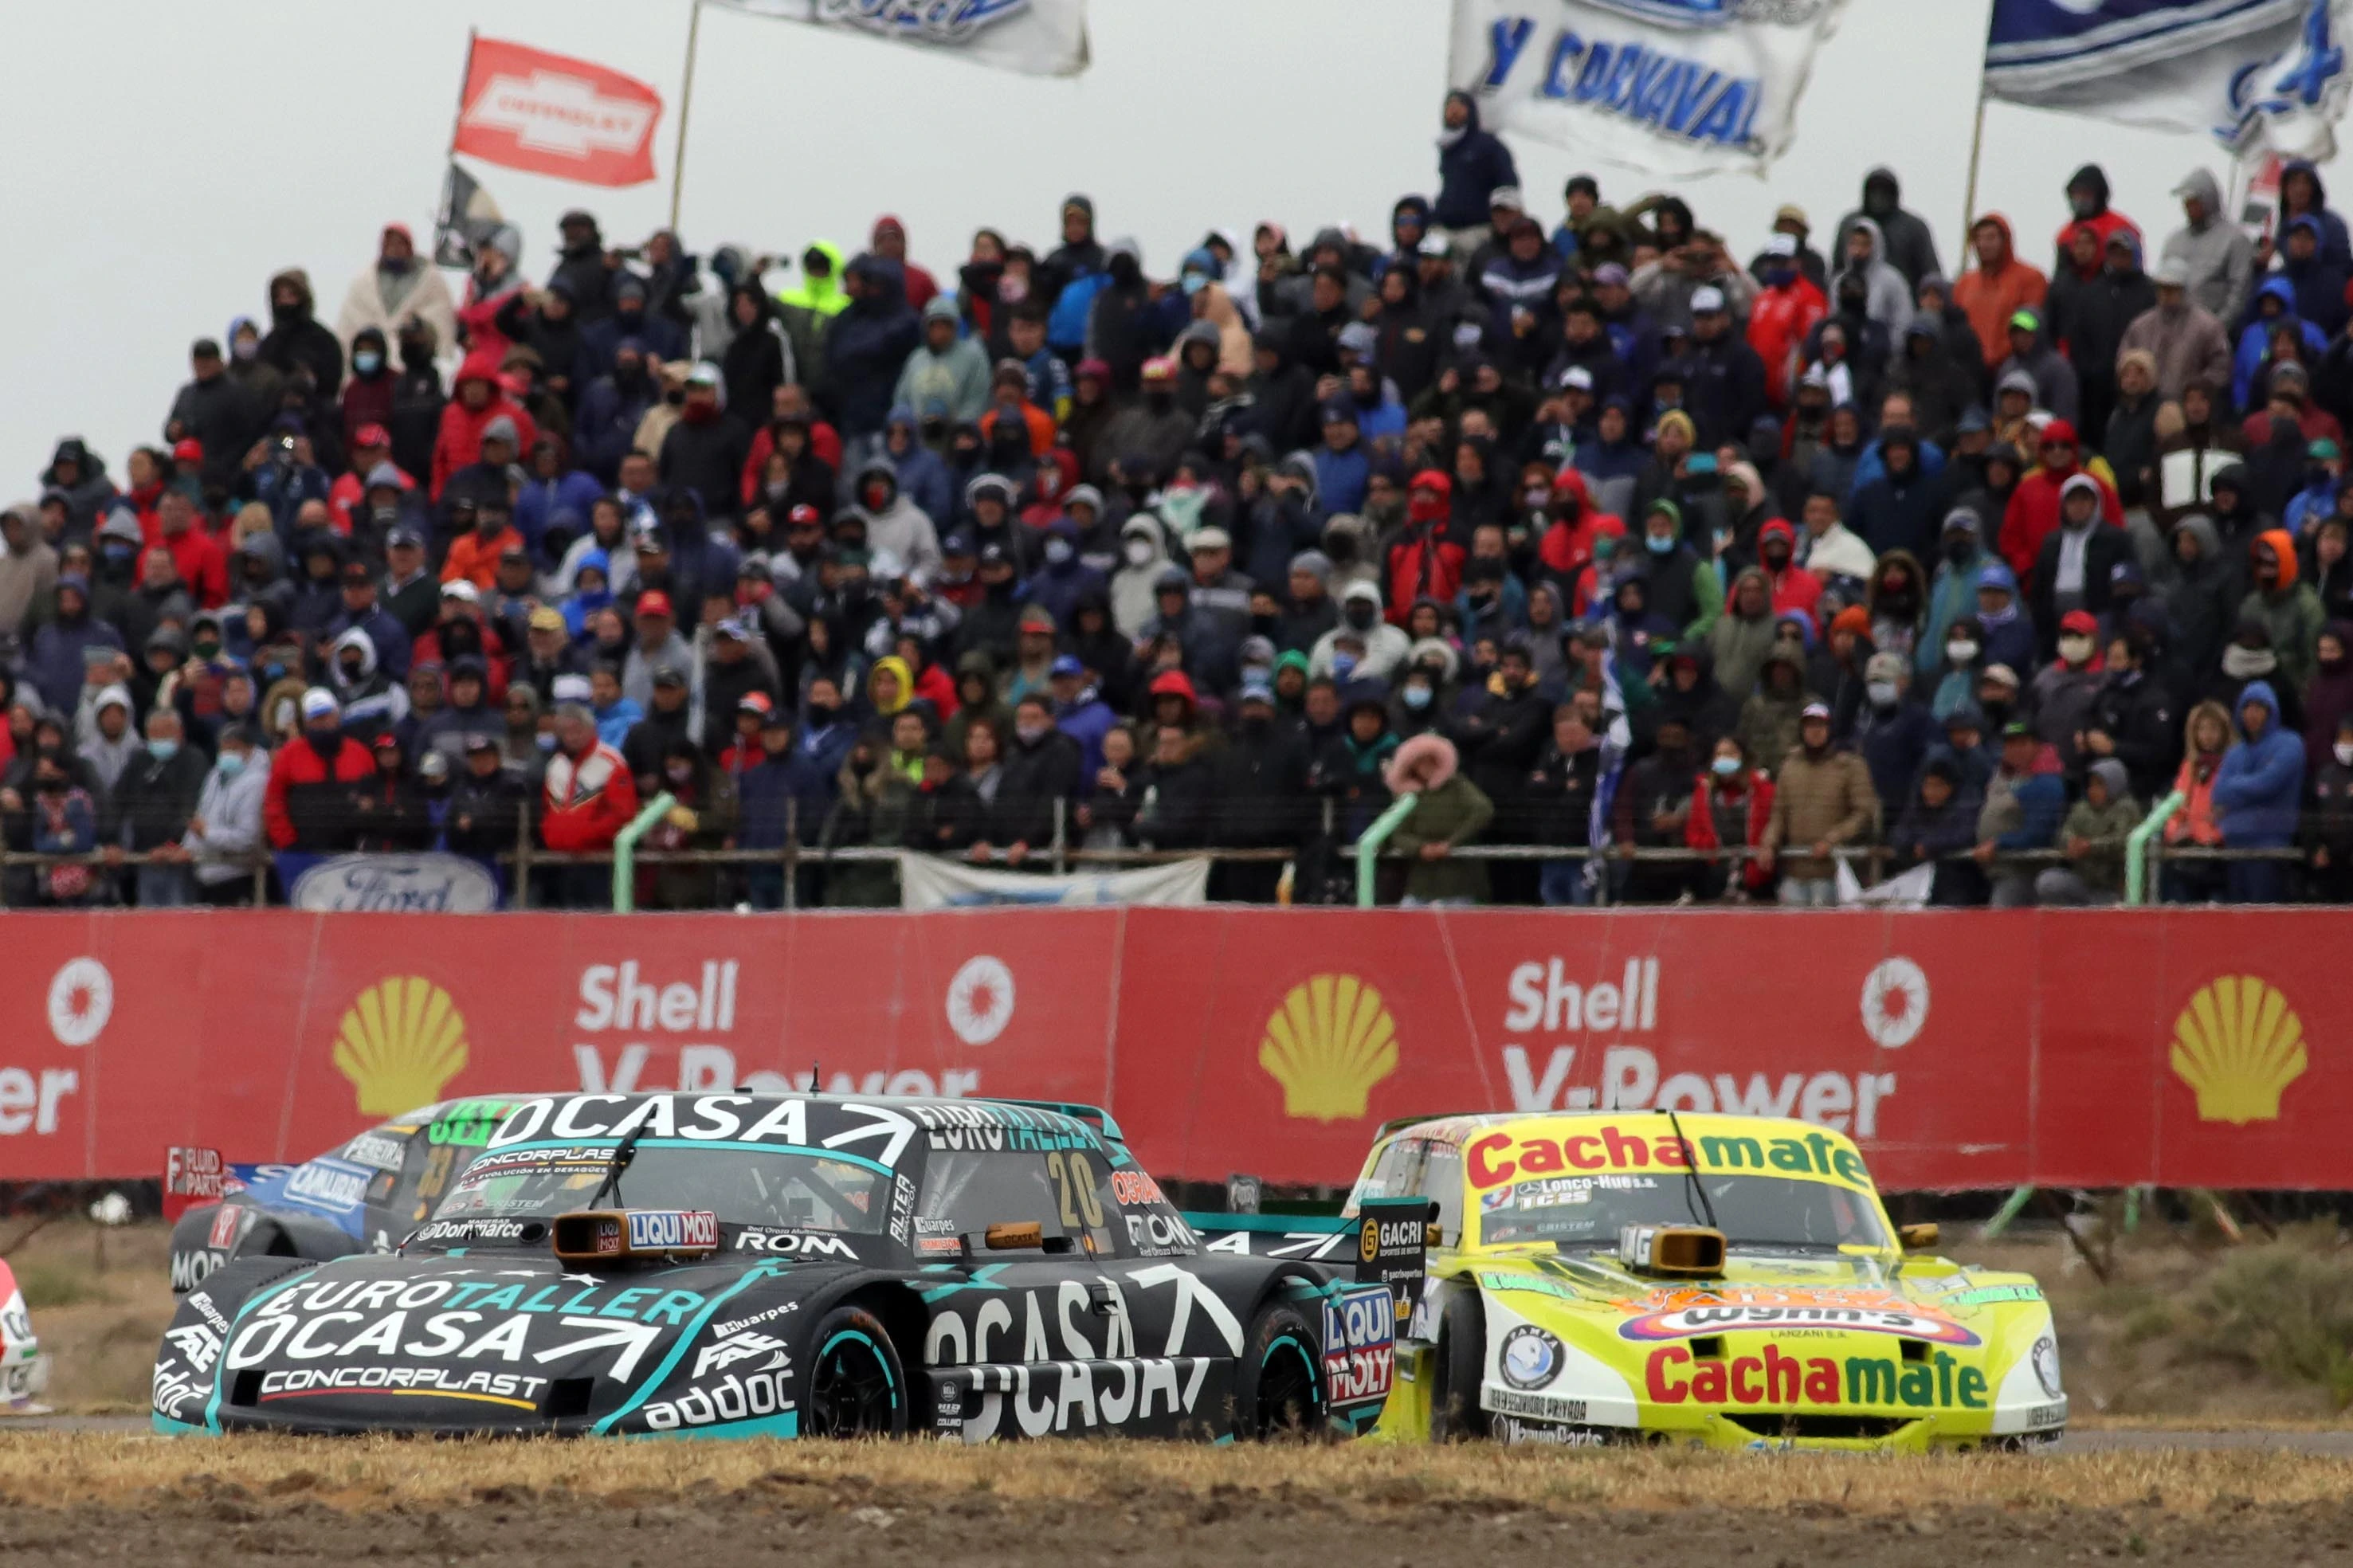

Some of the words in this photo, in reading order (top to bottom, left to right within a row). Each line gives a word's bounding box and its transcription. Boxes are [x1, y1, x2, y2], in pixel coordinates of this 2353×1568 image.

[1486, 16, 1535, 86] Y
[574, 958, 739, 1032] Shell
[1504, 956, 1660, 1032] Shell
[1502, 1045, 1896, 1137] V-Power
[186, 1147, 220, 1173] FLUID
[461, 1147, 636, 1177] CONCORPLAS
[554, 1165, 608, 1174] DESAGÜES
[1467, 1126, 1870, 1190] Cachamate
[1048, 1151, 1104, 1229] 20
[600, 1236, 620, 1251] MOLY
[631, 1214, 680, 1245] LIQUI
[681, 1213, 716, 1245] MOLY
[735, 1232, 860, 1260] ROM
[1380, 1221, 1422, 1247] GACRI
[256, 1280, 706, 1326] EUROTALLER
[712, 1301, 799, 1339] Huarpes
[261, 1367, 548, 1399] CONCORPLAST
[1327, 1347, 1392, 1401] MOLY
[1645, 1343, 1988, 1409] Cachamate
[643, 1370, 796, 1429] addoc
